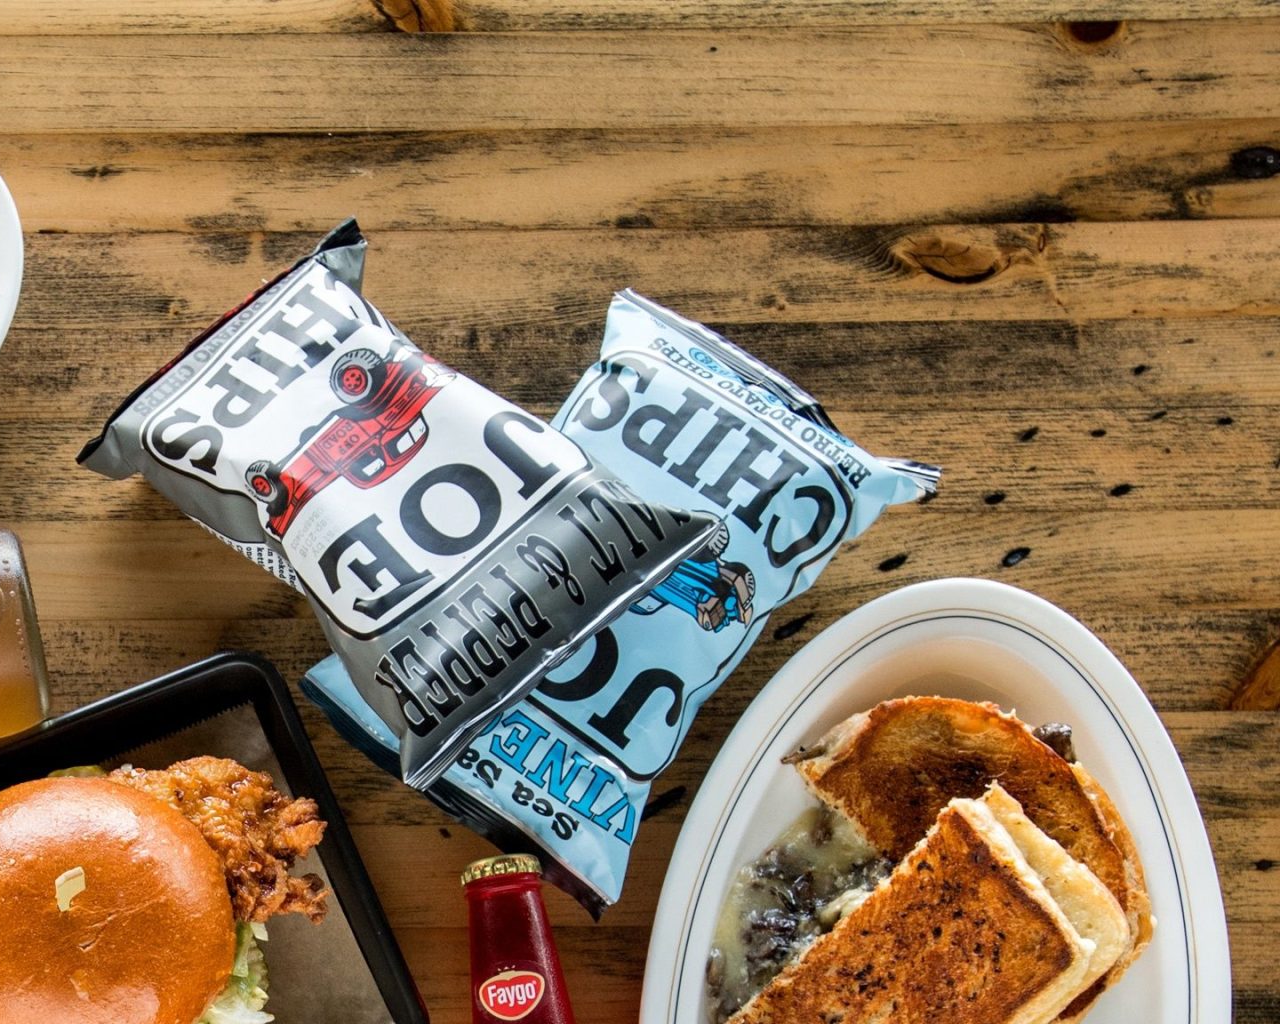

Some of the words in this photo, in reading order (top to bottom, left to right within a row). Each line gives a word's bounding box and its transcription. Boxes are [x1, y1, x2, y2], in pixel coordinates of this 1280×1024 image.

[133, 362, 196, 417] CHIPS
[648, 338, 714, 380] CHIPS
[323, 421, 354, 451] ROAD
[718, 379, 802, 431] POTATO
[575, 357, 838, 570] CHIPS
[801, 426, 872, 490] RETRO
[318, 411, 558, 620] JOE
[515, 533, 587, 606] &
[374, 563, 554, 738] PEPPER
[534, 626, 686, 750] JO
[455, 748, 503, 789] Sa
[477, 709, 637, 847] VINE
[511, 779, 580, 841] Sea
[487, 981, 536, 1008] Faygo
